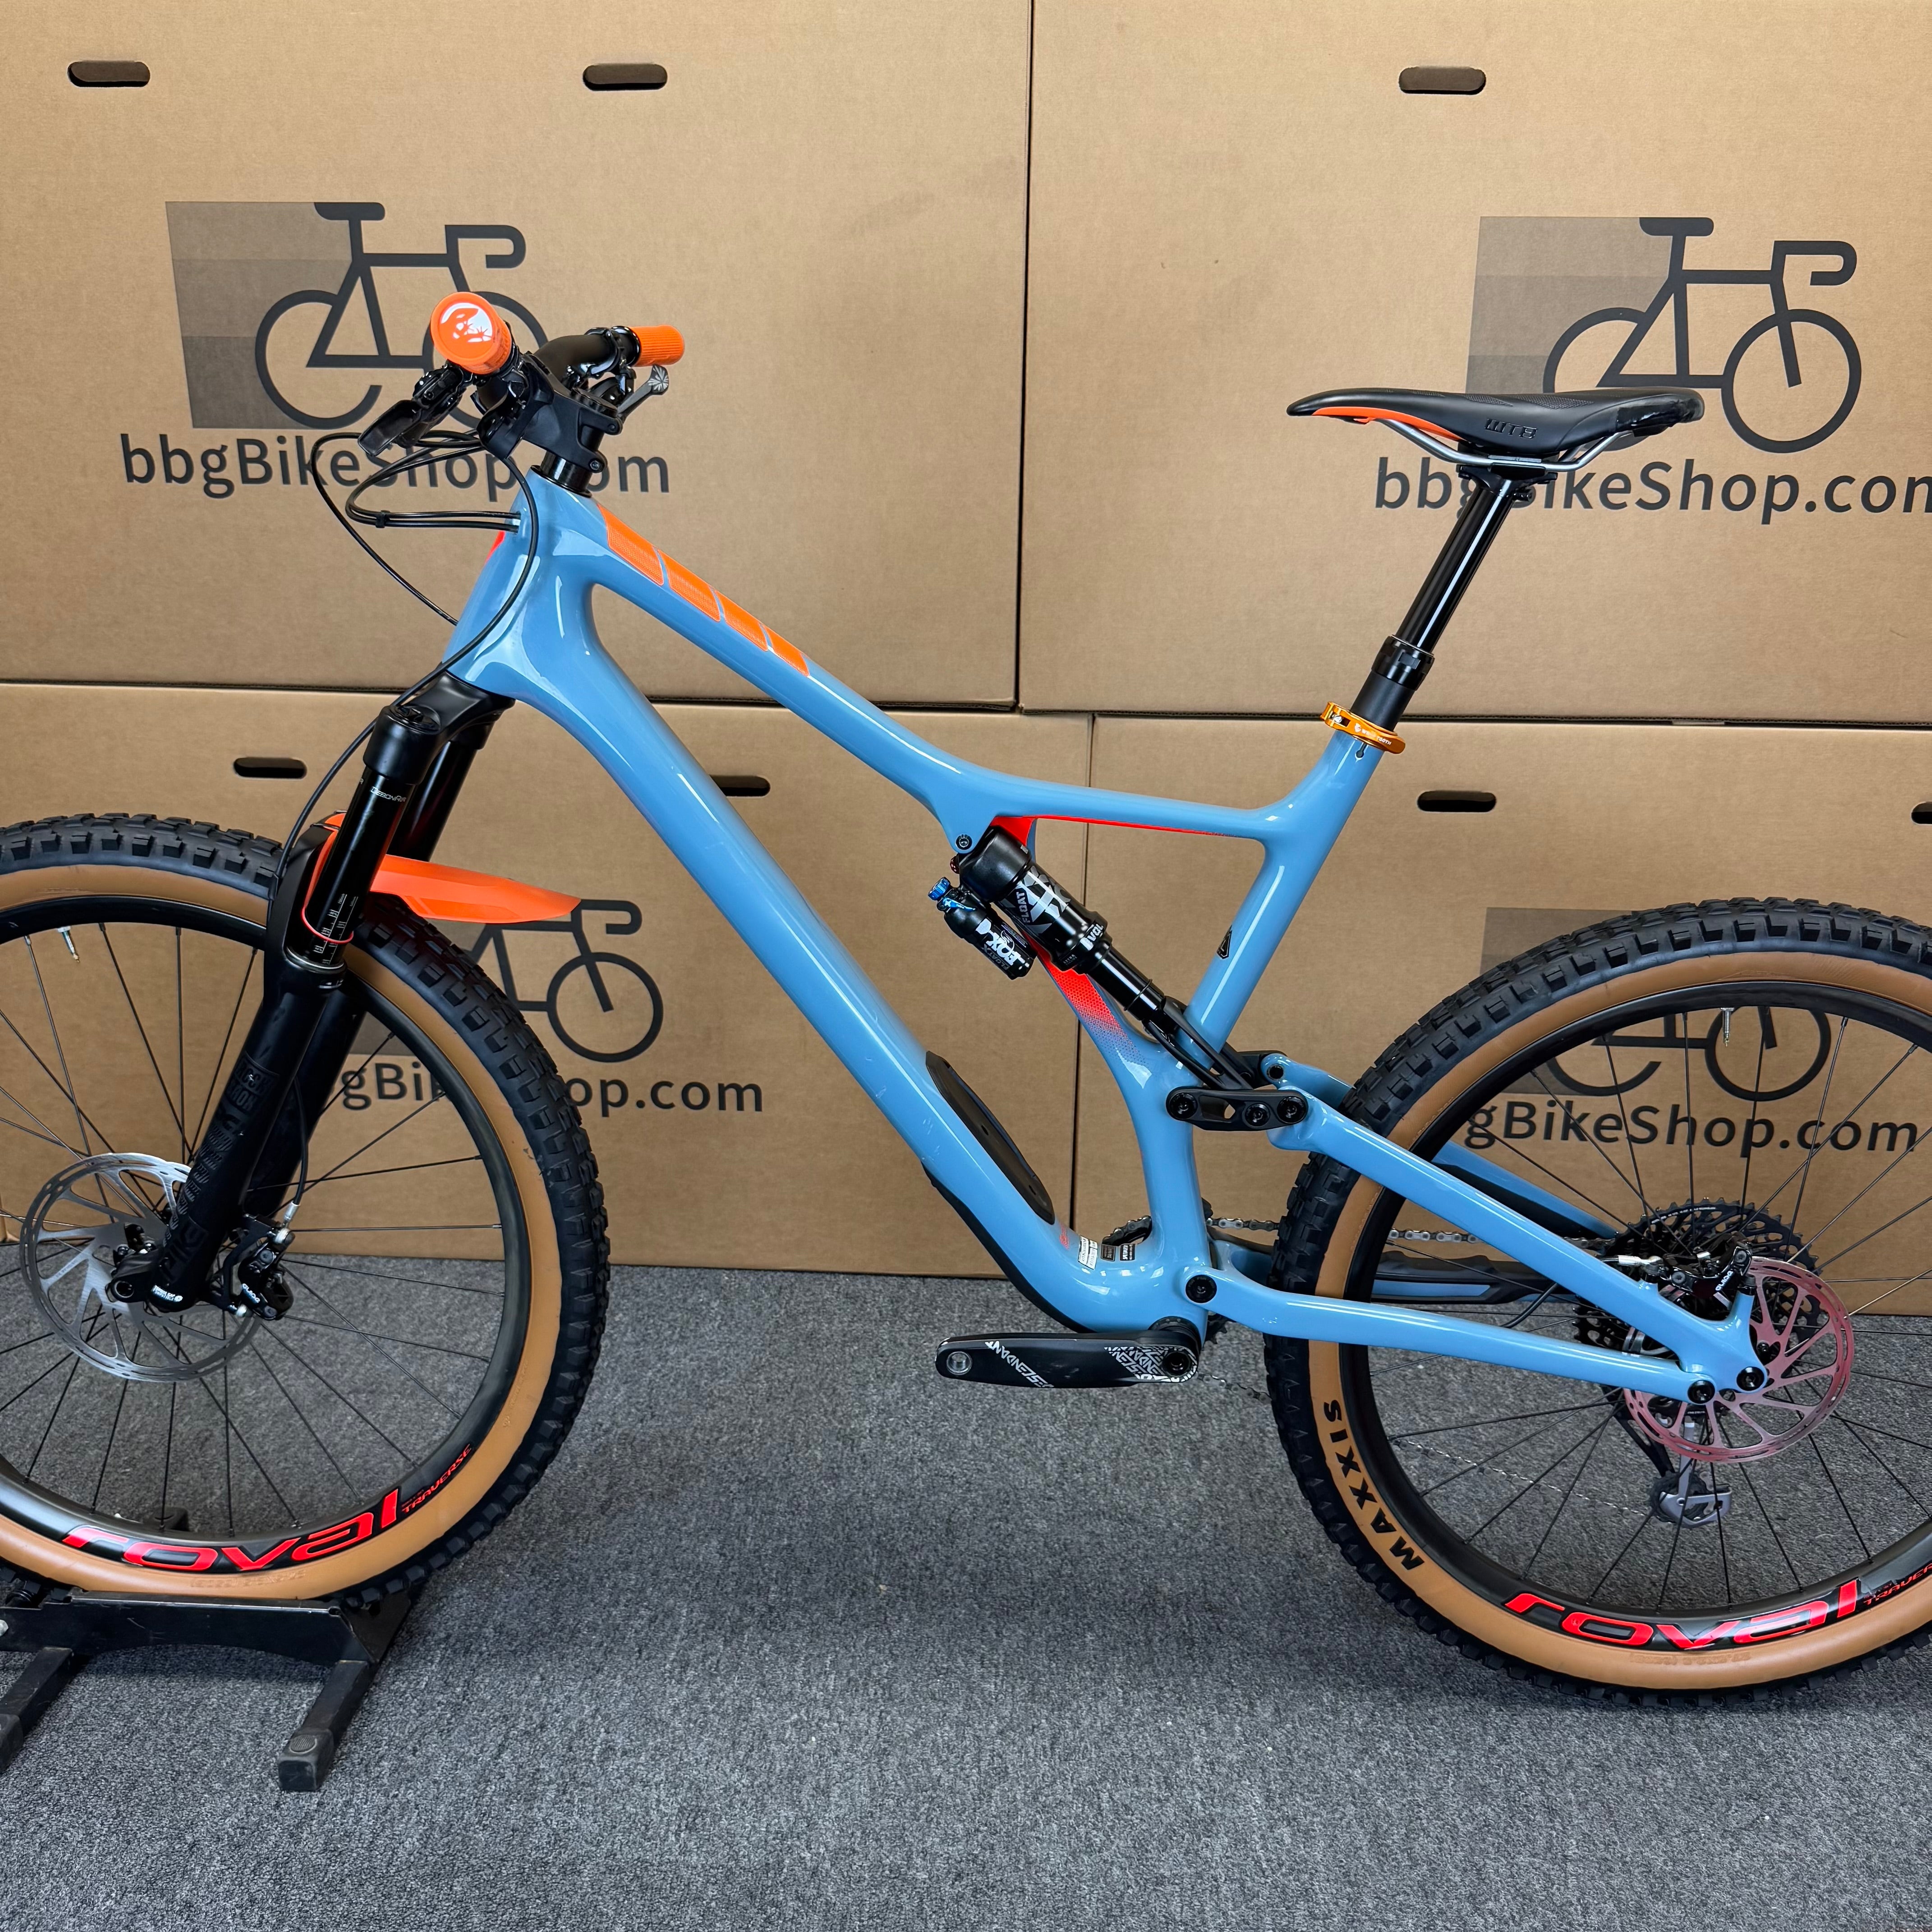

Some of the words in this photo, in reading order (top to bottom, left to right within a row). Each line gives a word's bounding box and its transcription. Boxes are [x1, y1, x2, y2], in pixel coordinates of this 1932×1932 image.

[1484, 419, 1538, 440] WTB
[986, 930, 1021, 966] FOX
[1324, 1400, 1425, 1570] MAXXIS
